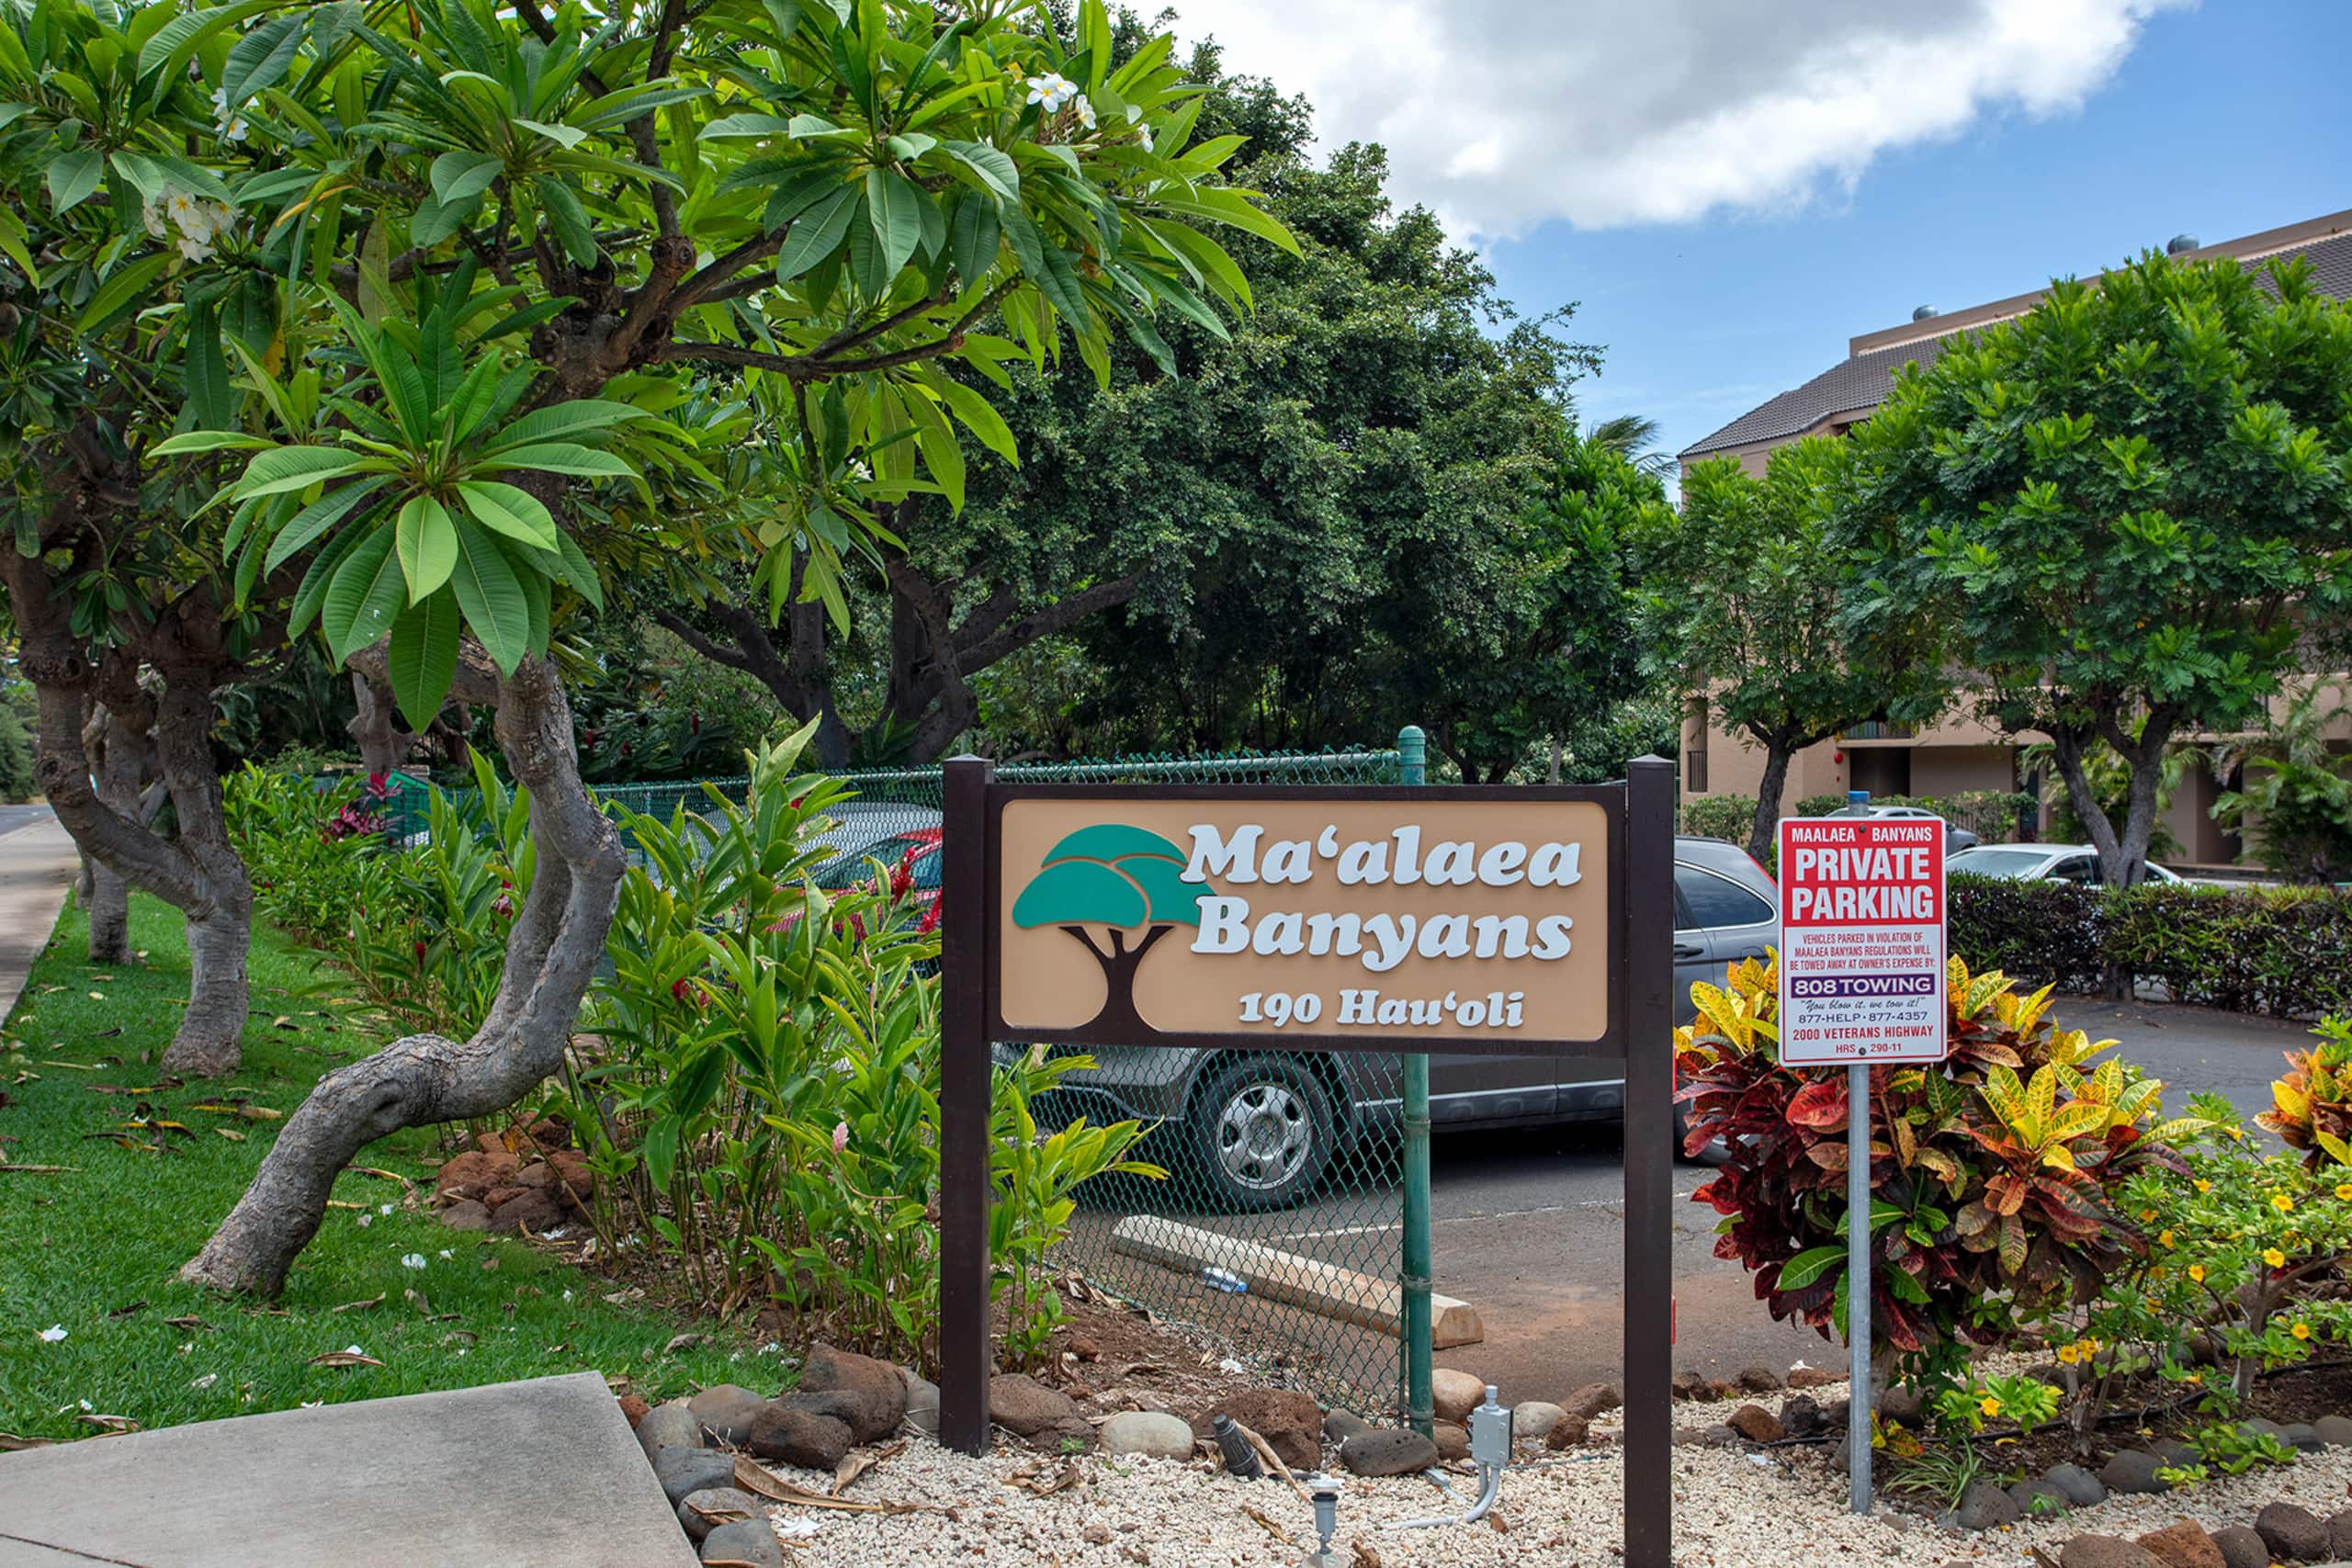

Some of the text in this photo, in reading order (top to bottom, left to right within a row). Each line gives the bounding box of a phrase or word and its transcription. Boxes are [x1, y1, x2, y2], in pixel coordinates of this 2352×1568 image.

[1792, 827, 1932, 842] MAALAEA BANYANS
[1795, 848, 1930, 882] PRIVATE
[1792, 886, 1934, 920] PARKING
[1190, 895, 1573, 972] Banyans
[1803, 932, 1923, 945] VEHICLES PARKED IN VIOLATION OF
[1795, 945, 1931, 957] MAALAEA BANYANS REGULATIONS WILL
[1790, 961, 1798, 970] BE
[1800, 960, 1825, 970] TOWED
[1826, 960, 1847, 970] AWAY
[1848, 959, 1857, 969] AT
[1893, 958, 1923, 968] EXPENSE
[1925, 958, 1935, 967] BY:
[1795, 977, 1931, 995] 808 TOWING
[1238, 992, 1323, 1029] 190
[1829, 999, 1851, 1010] blow
[1886, 999, 1904, 1008] tow
[1799, 1011, 1928, 1023] 877-HELP 877-4357
[1793, 1025, 1934, 1041] 2000 VETERANS HIGHWAY
[1836, 1043, 1901, 1054] HRS 290-11
